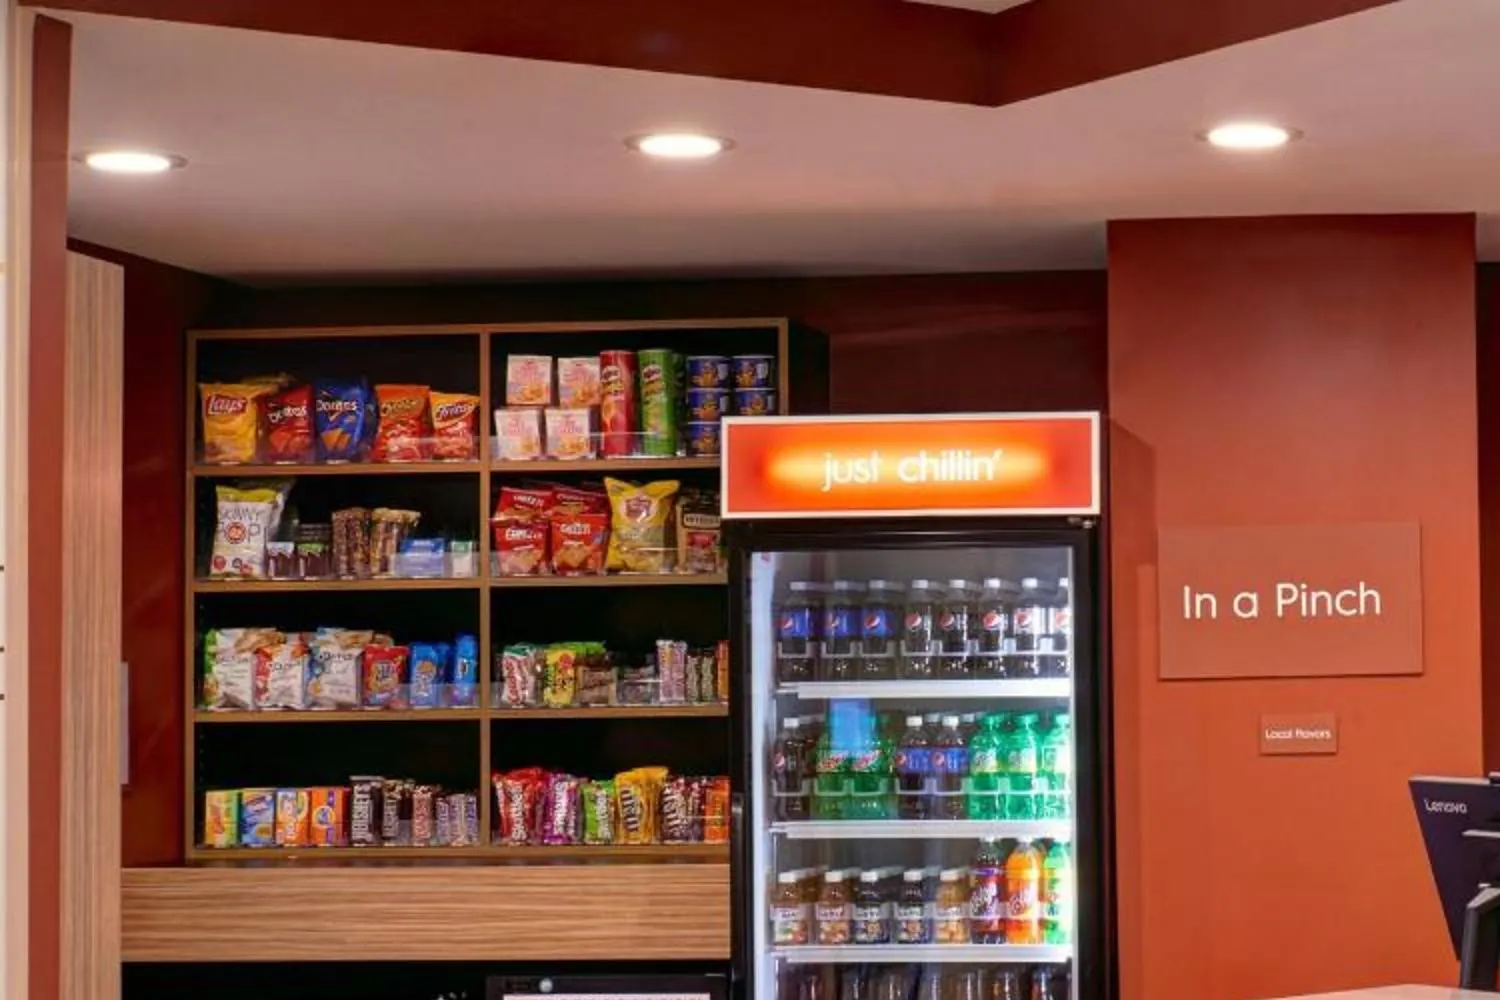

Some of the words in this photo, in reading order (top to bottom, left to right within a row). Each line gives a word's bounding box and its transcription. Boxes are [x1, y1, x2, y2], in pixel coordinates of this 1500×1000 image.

[821, 450, 882, 492] just
[1183, 585, 1217, 619] In
[1233, 591, 1258, 619] a
[1276, 581, 1381, 618] Pinch
[1264, 727, 1292, 739] Local
[1295, 727, 1331, 740] Flavors
[1423, 798, 1467, 814] Lenovo
